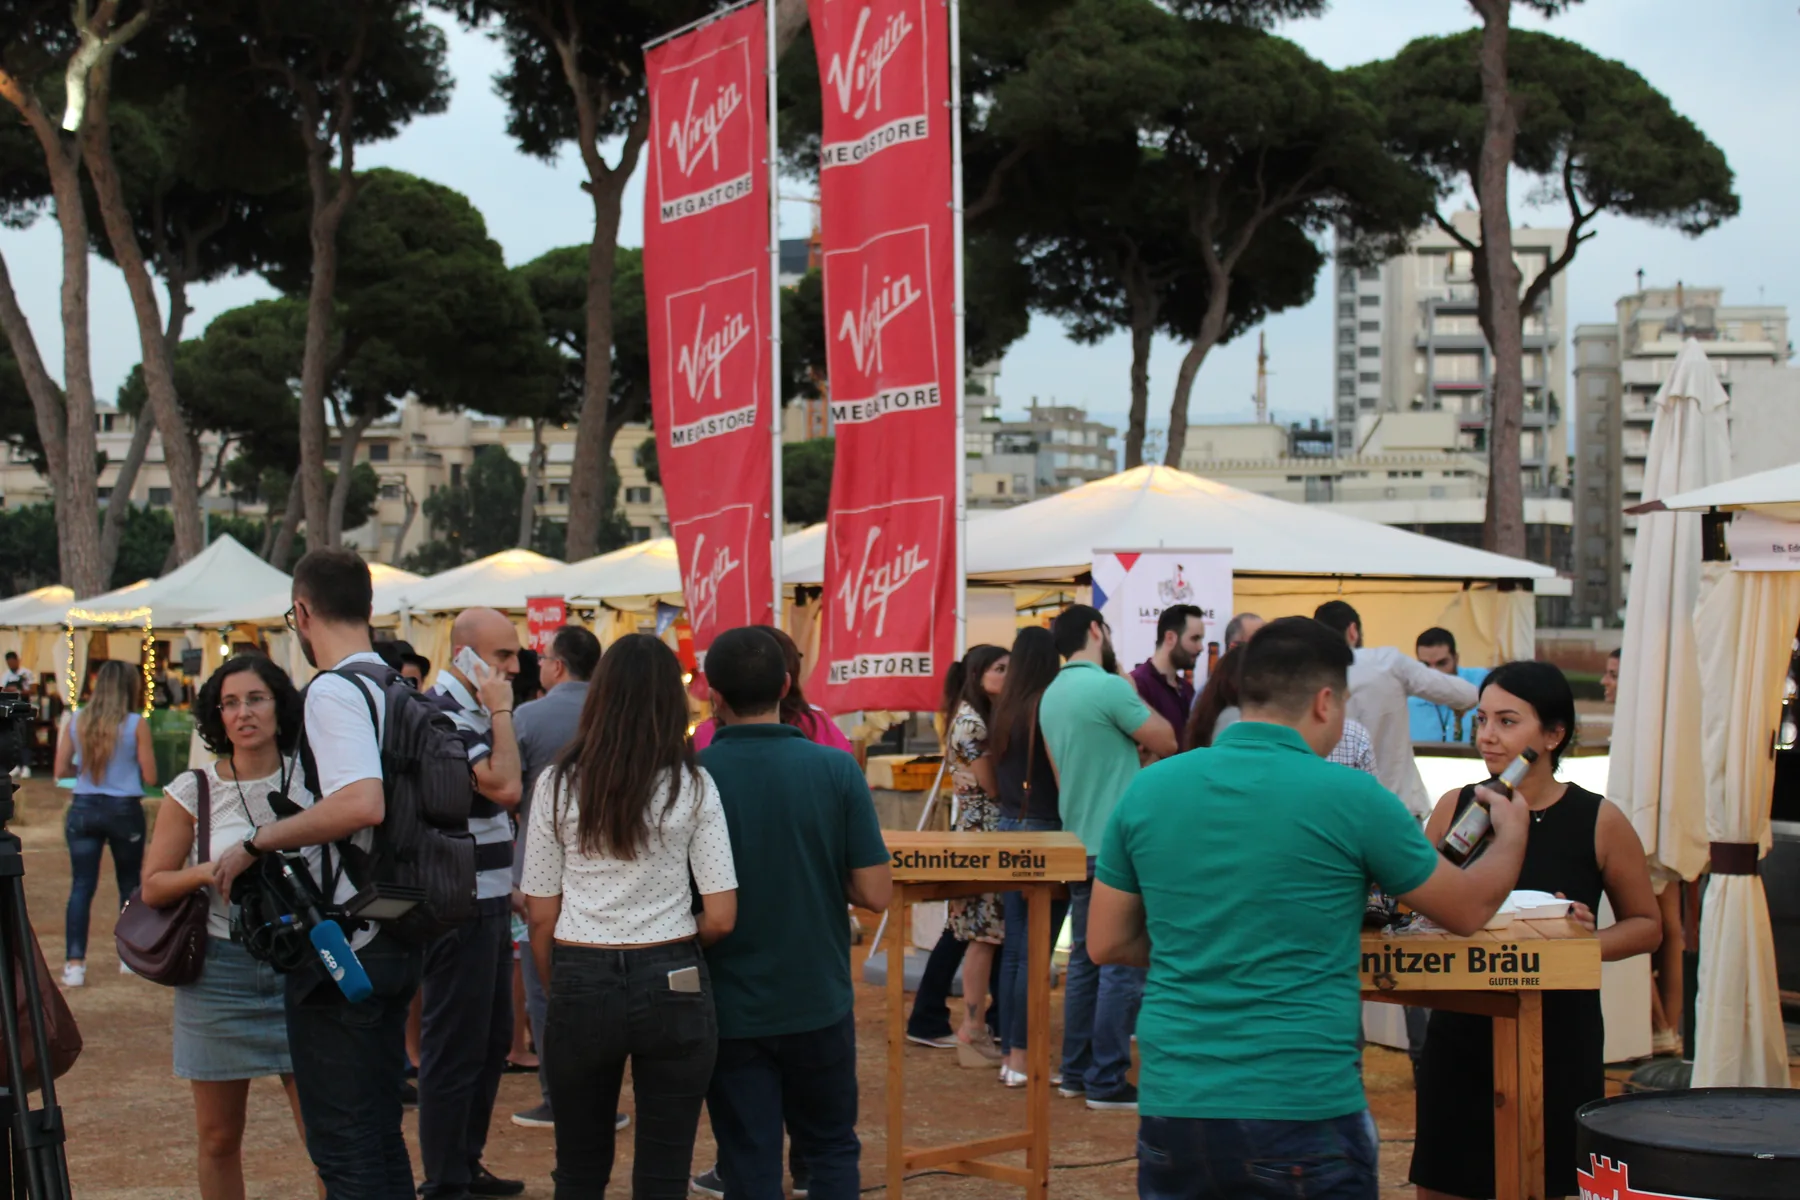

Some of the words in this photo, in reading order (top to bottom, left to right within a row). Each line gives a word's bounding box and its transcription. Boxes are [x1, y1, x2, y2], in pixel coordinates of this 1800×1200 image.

[827, 6, 913, 120] Virgin
[668, 77, 742, 178] Virgin
[662, 176, 752, 220] MEGASTORE
[678, 303, 750, 403] Virgin
[838, 263, 921, 378] Virgin
[832, 387, 938, 420] MEGATORE
[685, 533, 739, 635] Virgin
[892, 850, 990, 869] Schnitzer
[998, 850, 1046, 869] Bräu
[1362, 944, 1456, 973] nitzer
[1468, 944, 1540, 973] Bräu
[1489, 977, 1519, 986] GLUTEN
[1521, 977, 1540, 986] FREE
